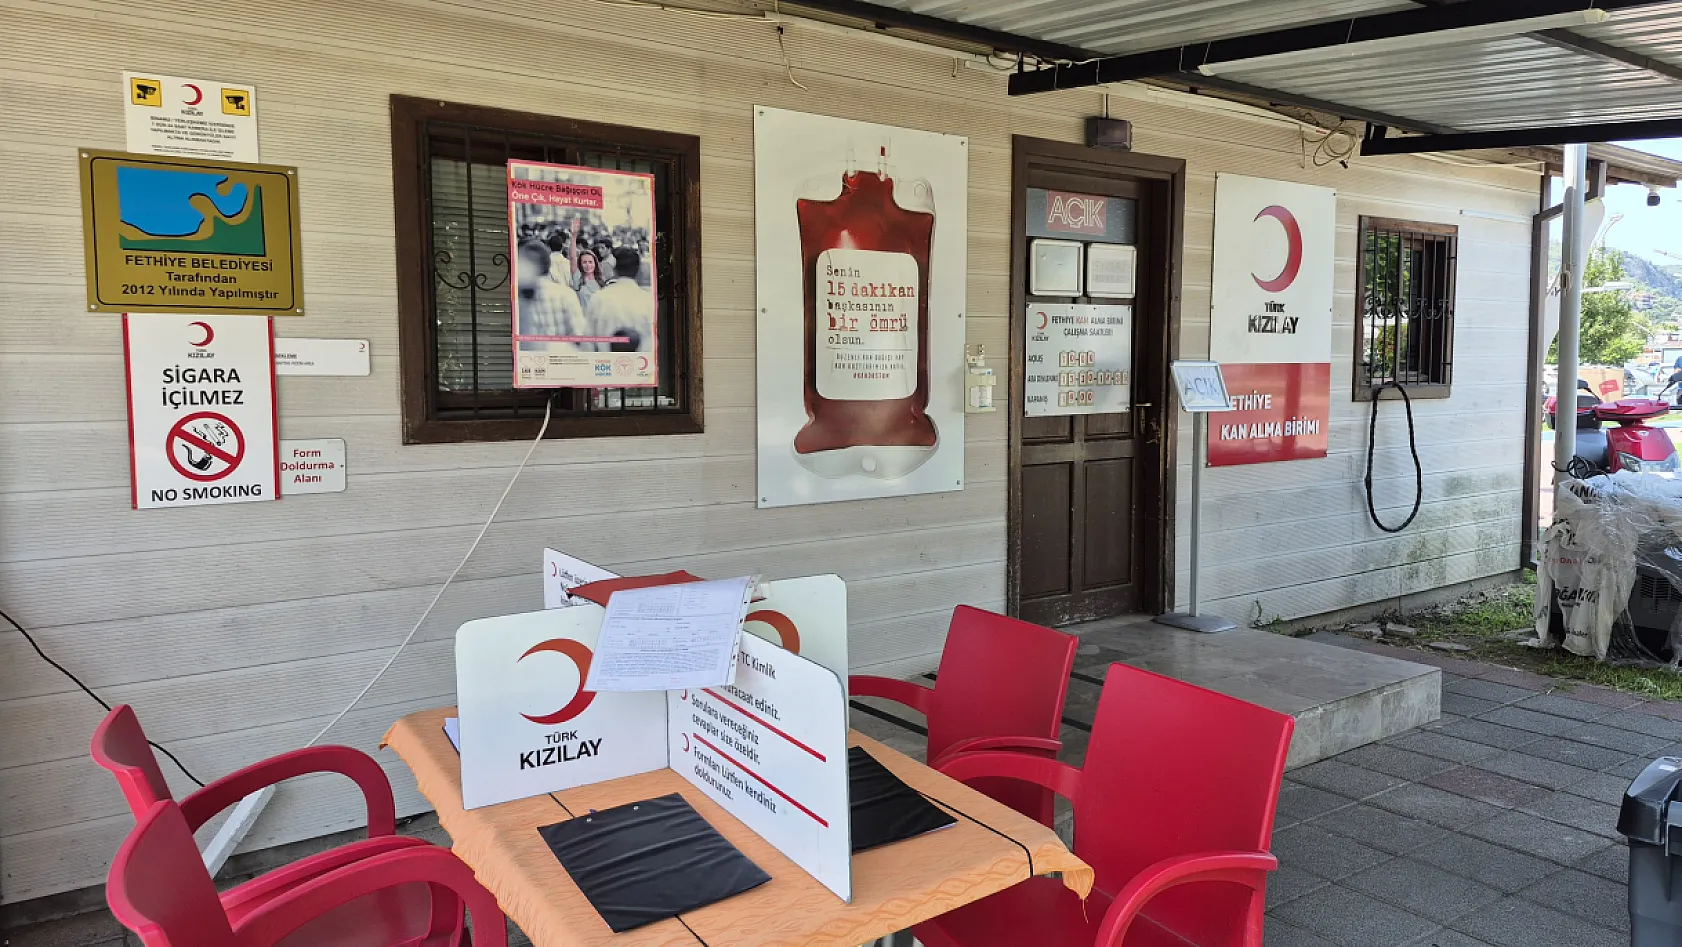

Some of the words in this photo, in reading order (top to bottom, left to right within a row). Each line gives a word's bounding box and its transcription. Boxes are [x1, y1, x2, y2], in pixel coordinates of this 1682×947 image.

[512, 180, 526, 188] Kök
[530, 182, 554, 192] Hücre
[512, 190, 529, 200] Öne
[550, 194, 572, 204] Hayat
[1048, 196, 1104, 228] AÇIK
[126, 254, 186, 268] FETHİYE
[192, 258, 274, 272] BELEDİYESİ
[826, 265, 860, 278] Senin
[166, 271, 237, 284] Tarafından
[122, 284, 154, 295] 2012
[159, 285, 205, 297] Yılında
[210, 287, 280, 302] Yapılmıştır
[827, 280, 846, 296] 15
[852, 282, 914, 298] dakikan
[827, 299, 894, 312] başkasının
[1264, 300, 1284, 313] TÜRK
[827, 312, 858, 331] bir
[870, 313, 908, 332] ömrü
[1076, 316, 1088, 324] KAN
[1248, 316, 1300, 334] KIZILAY
[828, 334, 865, 345] olsun.
[162, 364, 241, 384] SİGARA
[162, 387, 244, 410] İÇİLMEZ
[1228, 390, 1272, 410] ETHİYE
[1220, 424, 1247, 440] KAN
[1250, 421, 1282, 439] ALMA
[294, 449, 321, 458] Form
[280, 461, 334, 472] Doldurma
[294, 474, 322, 484] Alanı
[151, 489, 178, 502] NO
[183, 484, 262, 501] SMOKING
[741, 651, 750, 666] TC
[752, 656, 776, 679] Kimlik
[692, 693, 718, 720] Sorulara
[720, 713, 758, 744] vereceğiniz
[755, 698, 780, 722] ediniz.
[544, 730, 578, 745] TÜRK
[692, 713, 718, 738] cevaplar
[720, 730, 732, 748] size
[520, 738, 602, 770] KIZILAY
[746, 780, 776, 814] kendiniz
